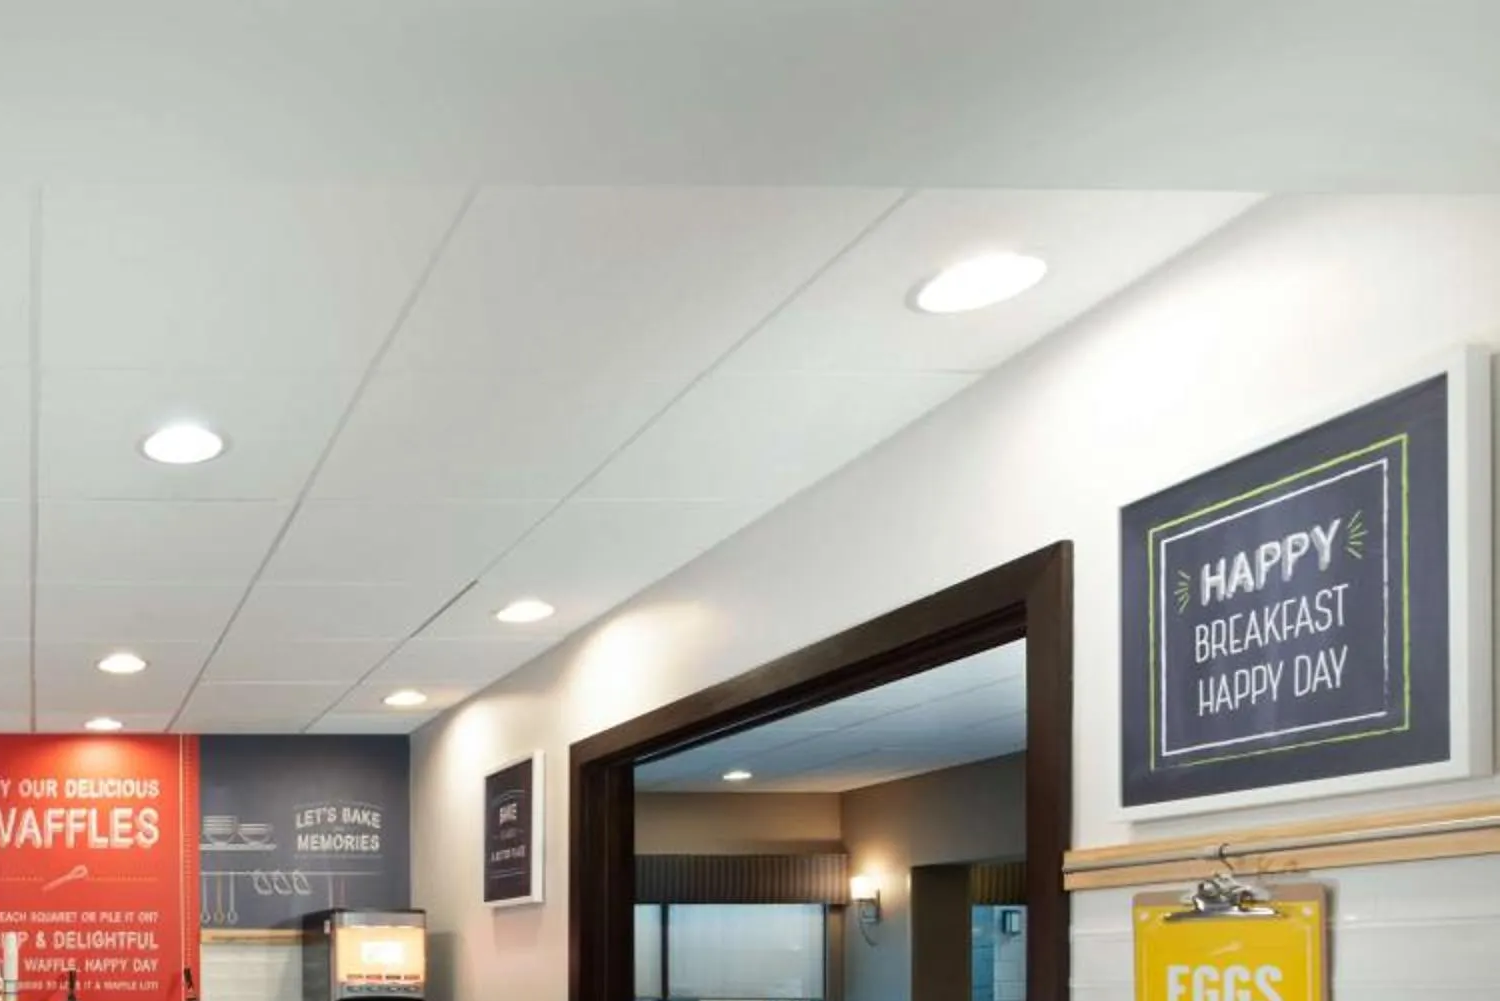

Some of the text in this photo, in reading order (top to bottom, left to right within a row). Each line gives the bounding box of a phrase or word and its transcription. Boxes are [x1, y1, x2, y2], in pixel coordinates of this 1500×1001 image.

[1201, 517, 1341, 606] HAPPY
[1194, 583, 1350, 664] BREAKFAST
[1199, 645, 1349, 717] HAPPY DAY
[18, 779, 57, 798] OUR
[64, 779, 160, 798] DELICIOUS
[296, 807, 382, 830] LET'S BAKE
[297, 833, 381, 852] MEMORIES
[0, 911, 27, 923] EACH
[99, 911, 121, 923] PILE
[36, 930, 47, 949] &
[53, 930, 159, 950] DELIGHTFUL
[85, 957, 127, 973] HAPPY
[133, 957, 159, 973] DAY
